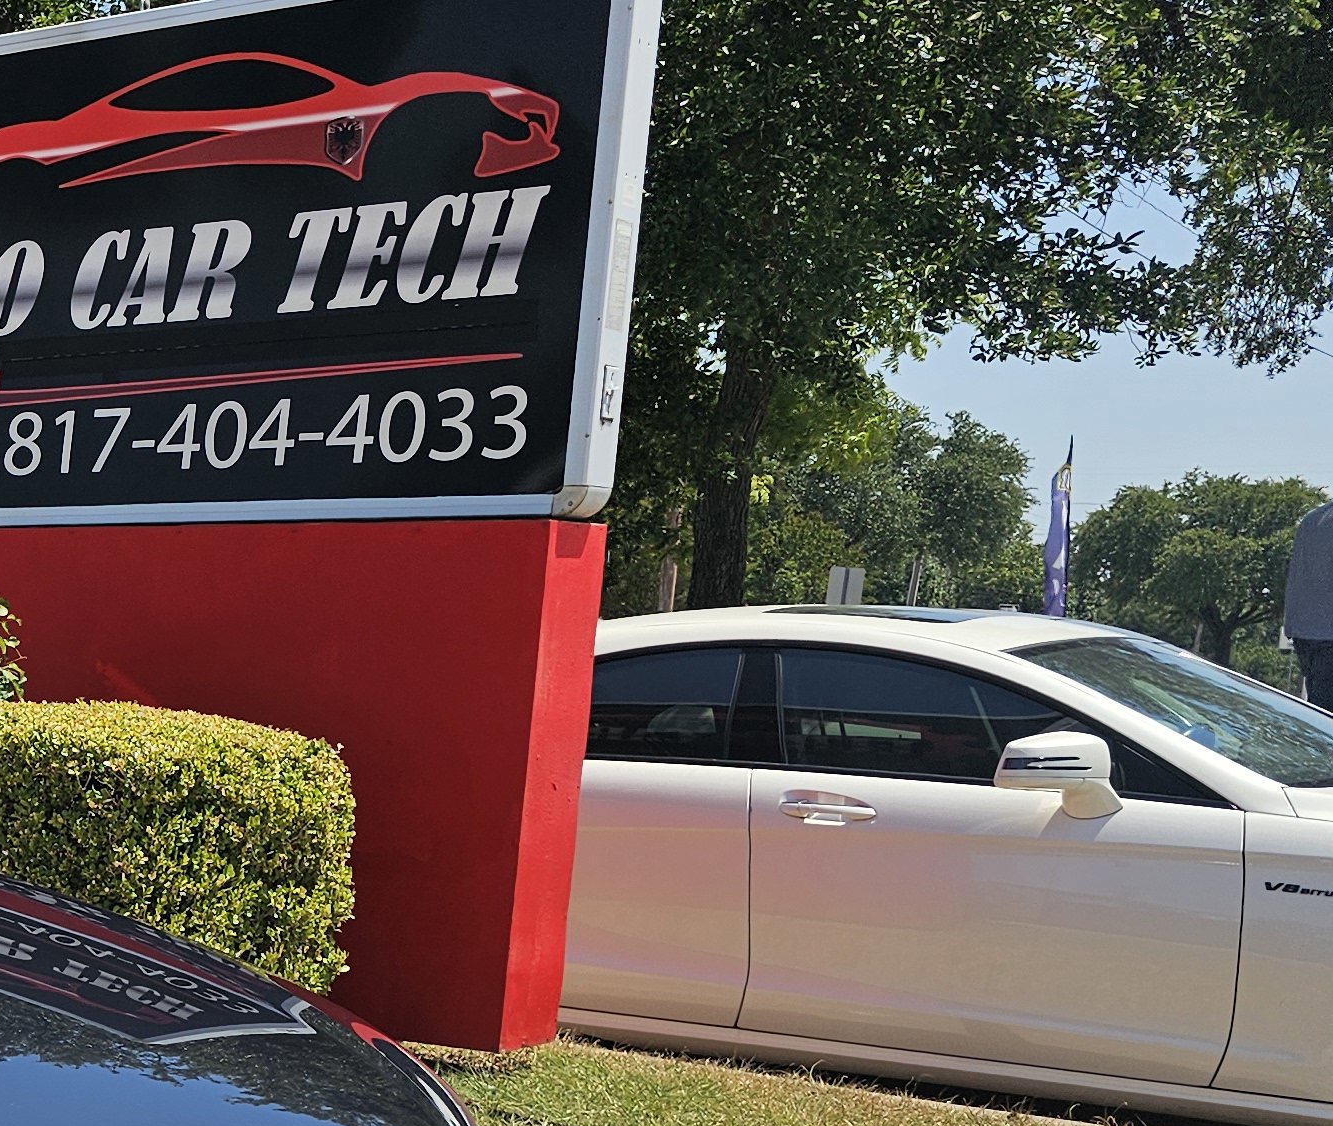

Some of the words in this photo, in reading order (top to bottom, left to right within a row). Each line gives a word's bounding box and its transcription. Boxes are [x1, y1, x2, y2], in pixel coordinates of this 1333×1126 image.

[70, 219, 252, 330] CAR
[276, 185, 552, 313] TECH
[2, 385, 529, 476] 817-404-4033
